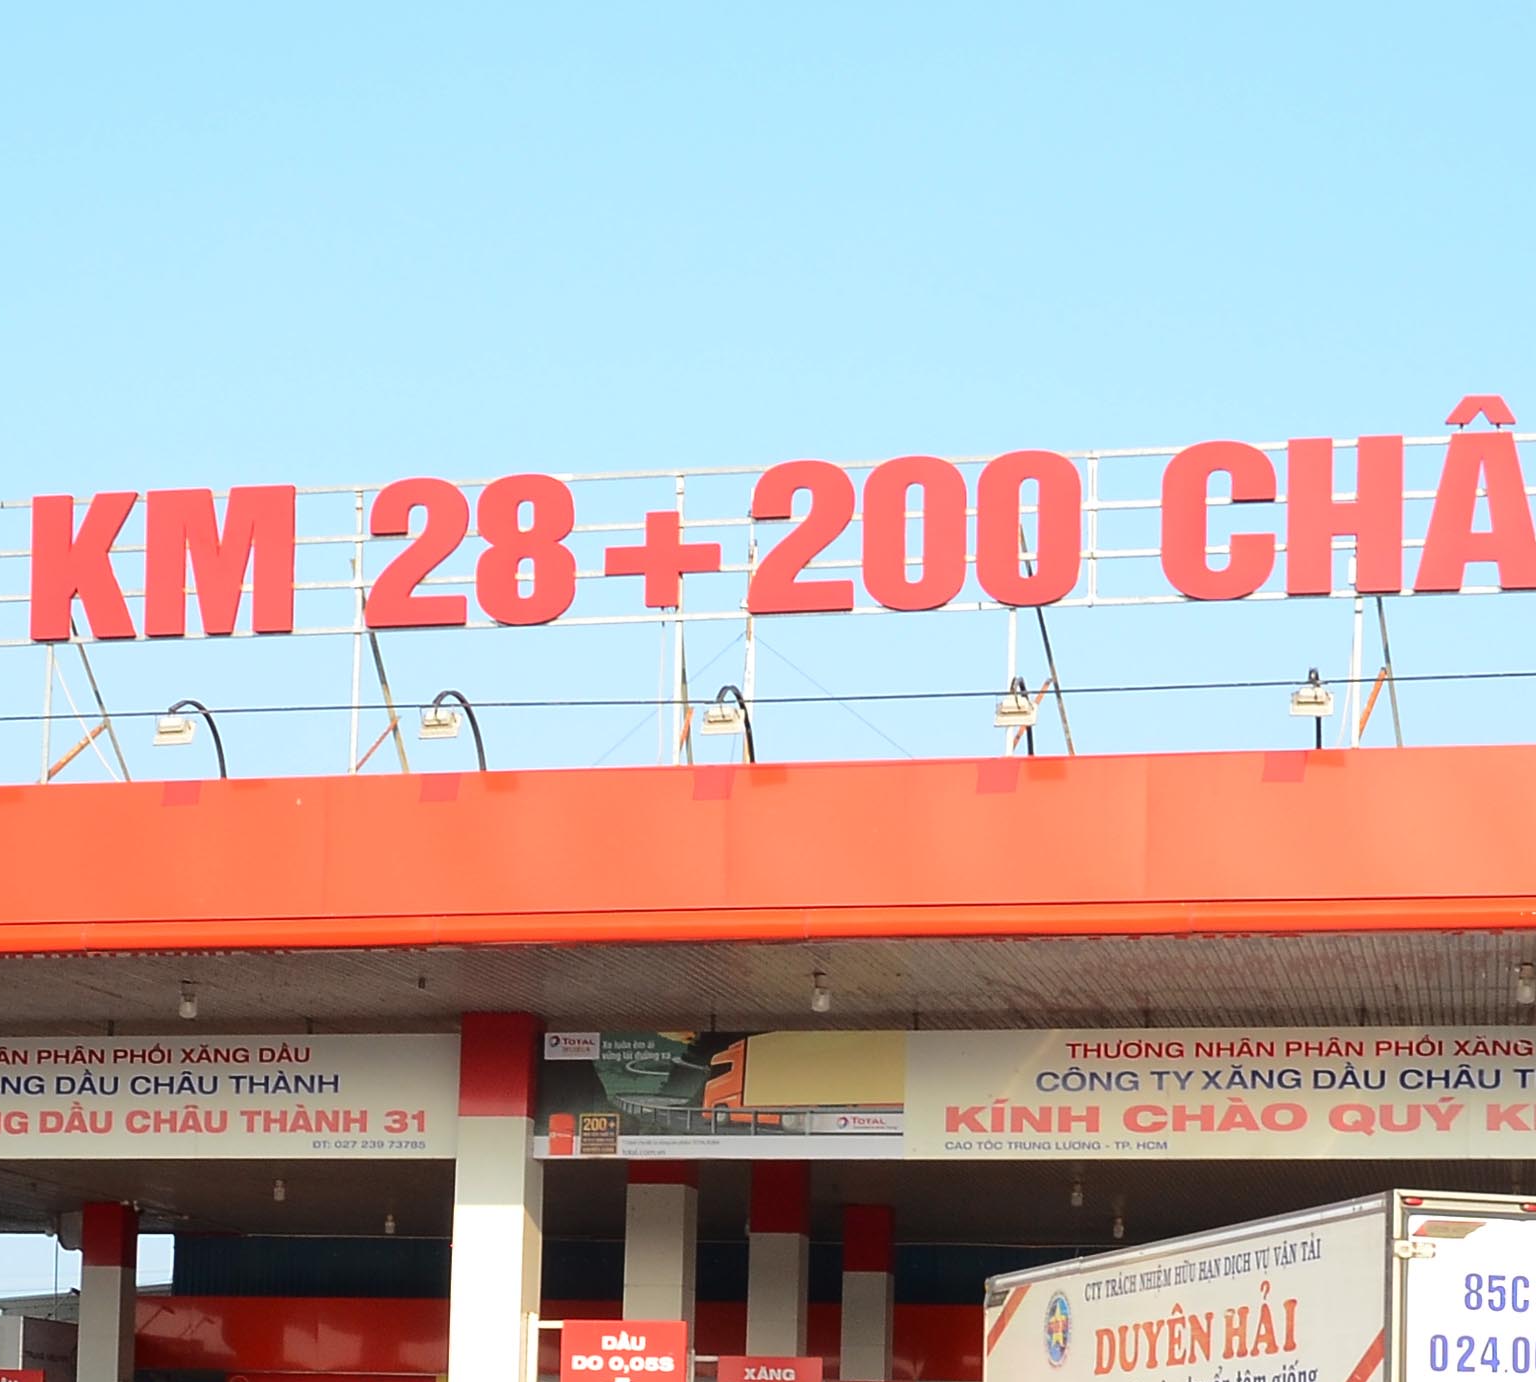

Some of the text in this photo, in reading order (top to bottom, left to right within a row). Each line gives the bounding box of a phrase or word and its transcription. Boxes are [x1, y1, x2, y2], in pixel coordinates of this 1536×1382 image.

[30, 484, 295, 644] KM
[37, 1046, 104, 1065] PHÂN
[113, 1042, 172, 1064] PHỐI
[180, 1043, 250, 1064] XĂNG
[258, 1043, 311, 1063] DẦU
[563, 1038, 595, 1046] TOTAL
[1066, 1039, 1184, 1059] THƯƠNG
[1194, 1037, 1275, 1058] NHÂN
[1285, 1036, 1365, 1058] PHÂN
[1375, 1034, 1443, 1057] PHỐI
[1453, 1036, 1534, 1056] XĂNG
[55, 1068, 119, 1095] DẦU
[130, 1071, 218, 1094] CHÂU
[229, 1071, 340, 1094] THÀNH
[1035, 1067, 1140, 1092] CÔNG
[1149, 1070, 1194, 1091] TY
[1201, 1064, 1302, 1090] XĂNG
[1312, 1061, 1386, 1090] DẦU
[1399, 1064, 1502, 1089] CHÂU
[39, 1102, 113, 1134] DẦU
[125, 1104, 229, 1134] CHÂU
[240, 1104, 368, 1134] THÀNH
[384, 1109, 427, 1133] 31
[850, 1116, 886, 1125] TOTAL
[945, 1098, 1100, 1133] KÍNH
[1122, 1097, 1308, 1133] CHÀO
[1328, 1097, 1465, 1136] QUÝ
[334, 1140, 357, 1149] 027
[361, 1140, 384, 1149] 239
[945, 1141, 973, 1150] CAO
[1007, 1140, 1050, 1150] TRUNG
[1136, 1141, 1168, 1150] HCM
[1084, 1280, 1102, 1302] CTY
[1105, 1272, 1137, 1299] TRÁCH
[1138, 1265, 1172, 1294] NHIỆM
[1199, 1258, 1221, 1284] HẠN
[1224, 1251, 1252, 1280] DỊCH
[1255, 1247, 1271, 1275] VỤ
[1273, 1240, 1299, 1270] VẬN
[1300, 1231, 1323, 1261] TẢI
[1463, 1273, 1531, 1313] 85C
[1094, 1280, 1298, 1376] DUYÊN HẢI
[571, 1355, 675, 1374] DO 0,05S
[743, 1366, 796, 1382] XĂNG
